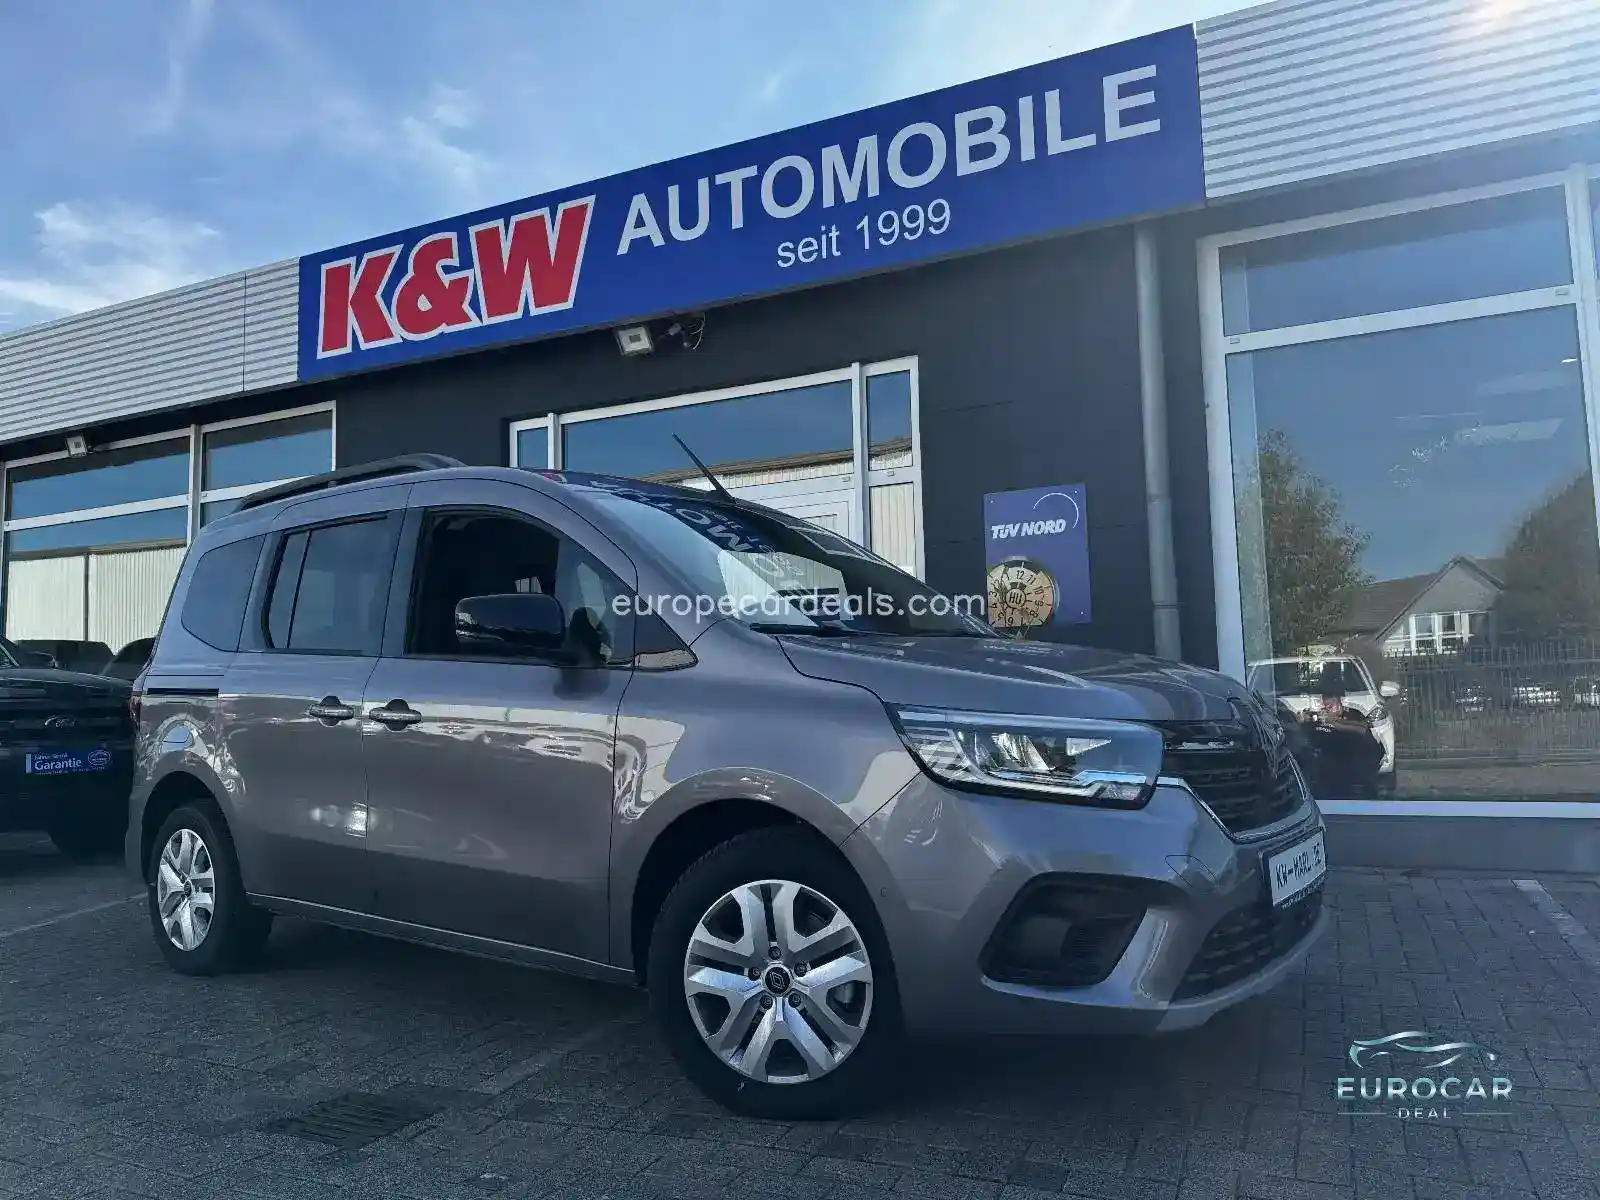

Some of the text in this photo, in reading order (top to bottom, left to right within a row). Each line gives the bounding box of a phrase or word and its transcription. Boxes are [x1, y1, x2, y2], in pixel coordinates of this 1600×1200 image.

[617, 65, 1161, 256] AUTOMOBILE
[777, 199, 951, 268] seit 1999
[317, 195, 596, 359] K&W
[991, 518, 1067, 539] TÜV NORD
[1008, 591, 1023, 605] HU
[34, 757, 82, 770] Garantie
